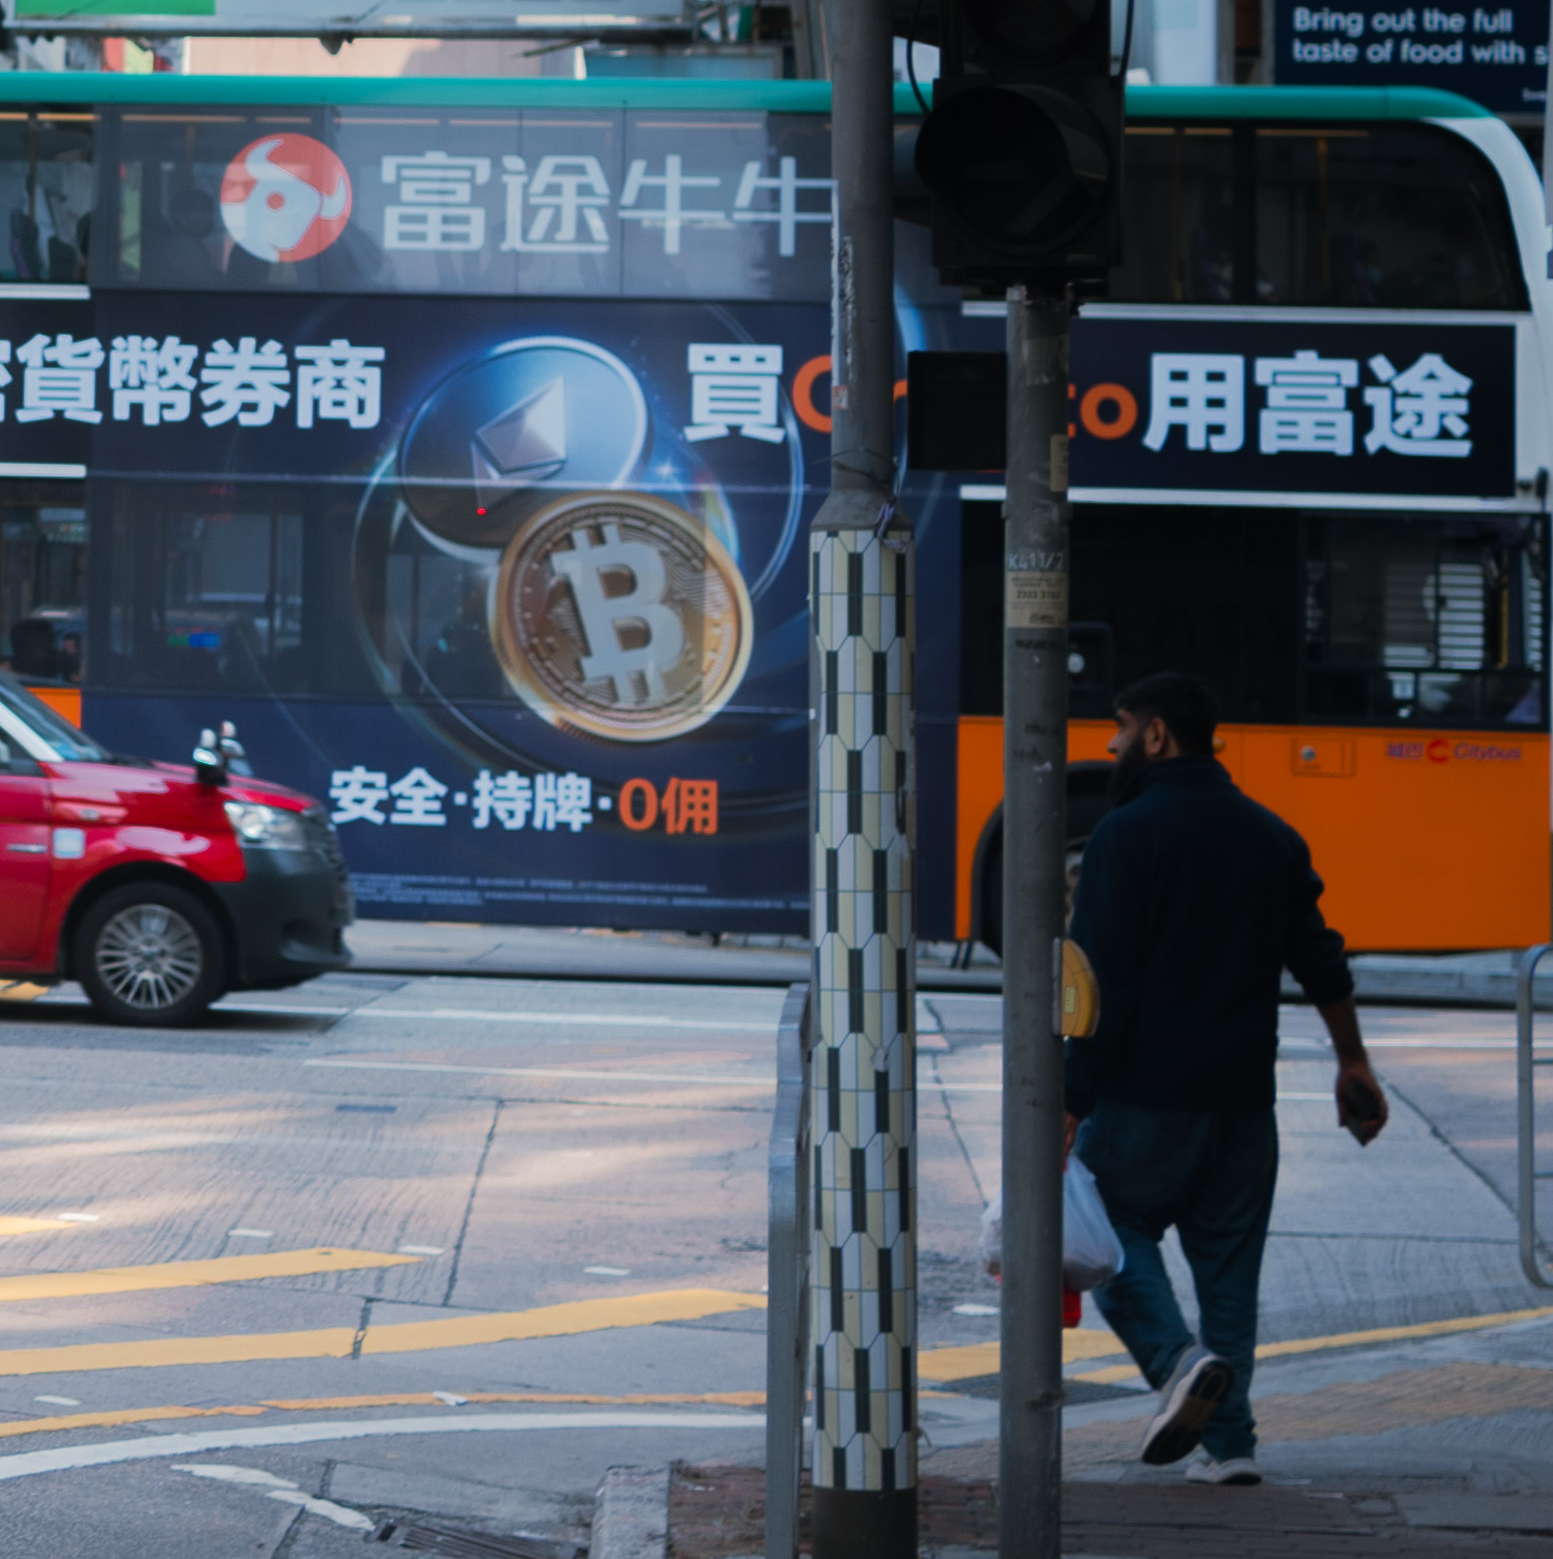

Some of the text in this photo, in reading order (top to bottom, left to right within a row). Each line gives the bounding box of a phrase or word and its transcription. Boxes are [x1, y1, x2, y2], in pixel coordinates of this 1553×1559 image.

[1293, 7, 1514, 38] Bring out the full
[1292, 38, 1359, 63] taste
[1366, 38, 1394, 64] of
[1400, 38, 1463, 64] food
[1471, 40, 1526, 65] with
[380, 150, 838, 258] 富途牛牛
[1453, 742, 1522, 761] Citybus
